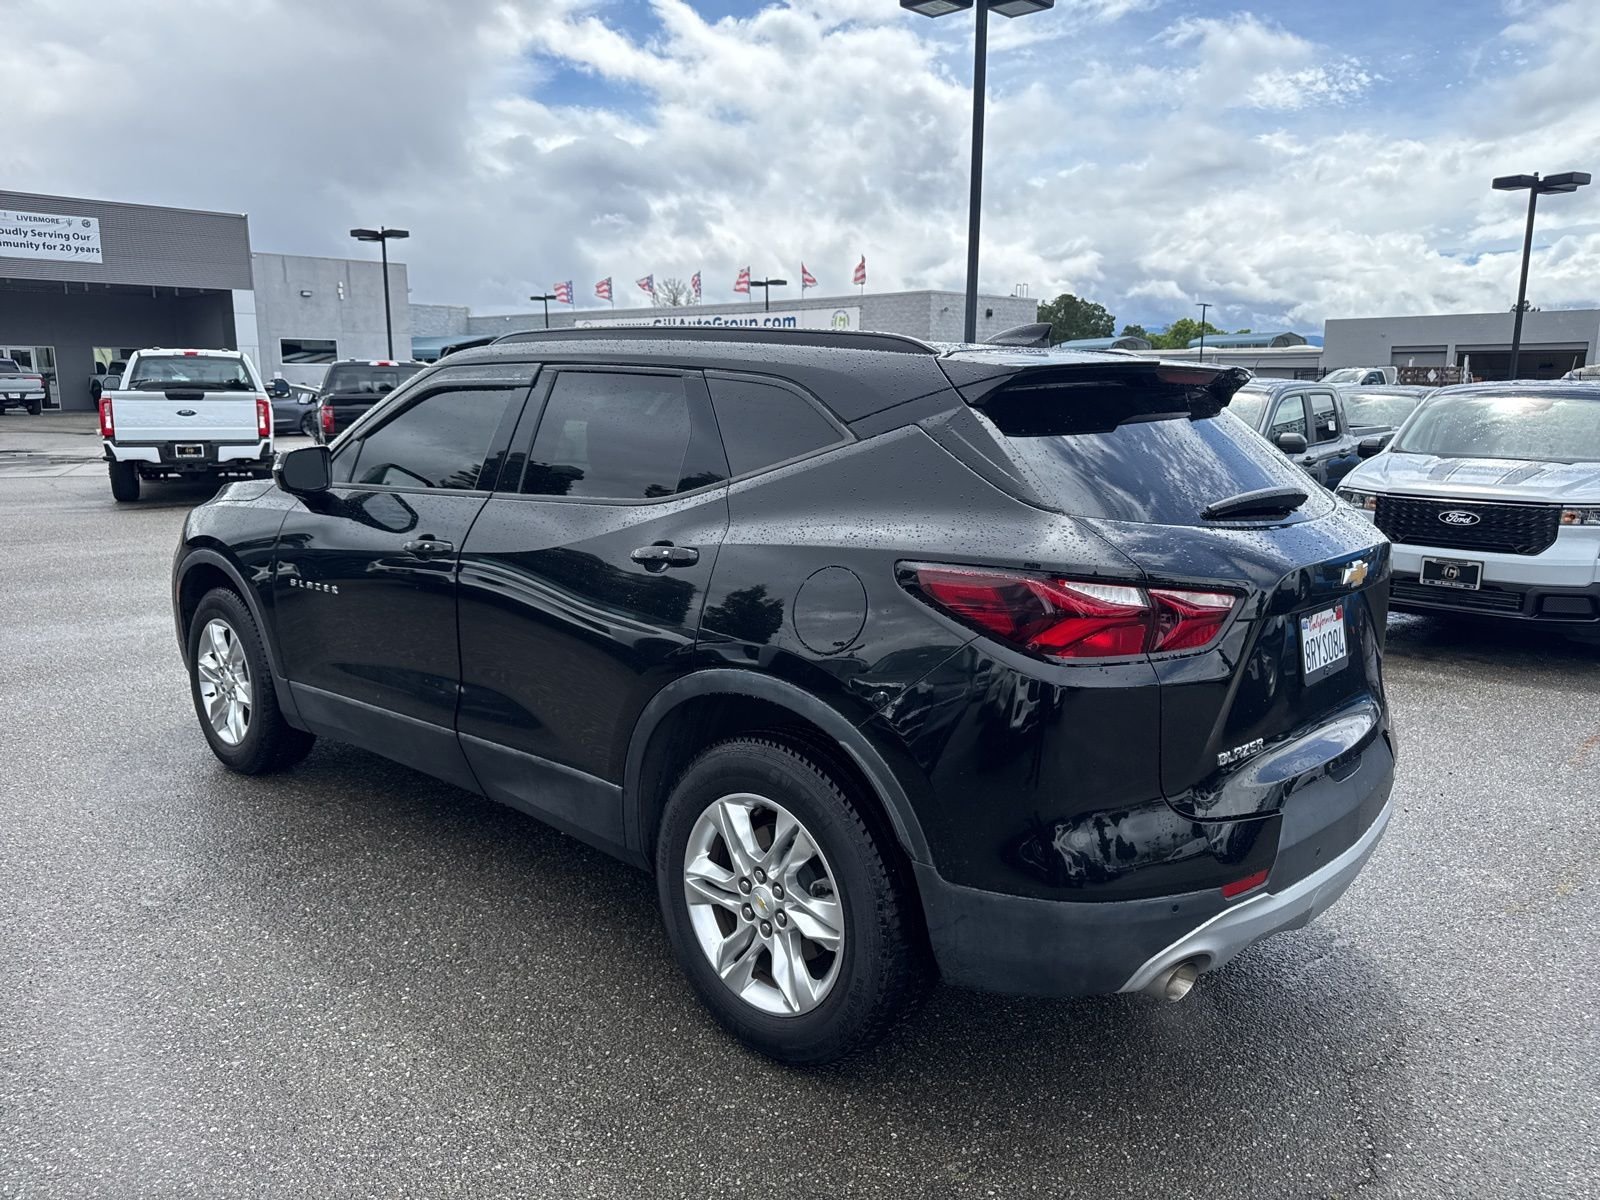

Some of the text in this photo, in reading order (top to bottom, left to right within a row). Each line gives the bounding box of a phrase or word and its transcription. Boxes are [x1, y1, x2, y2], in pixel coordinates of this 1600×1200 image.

[16, 214, 60, 224] LIVERMORE
[31, 229, 70, 241] Serving
[72, 232, 91, 241] Our
[0, 240, 100, 254] munity for 20 years
[1445, 512, 1472, 524] Ford
[290, 578, 339, 594] BLAZER
[1217, 737, 1264, 766] BLAZER
